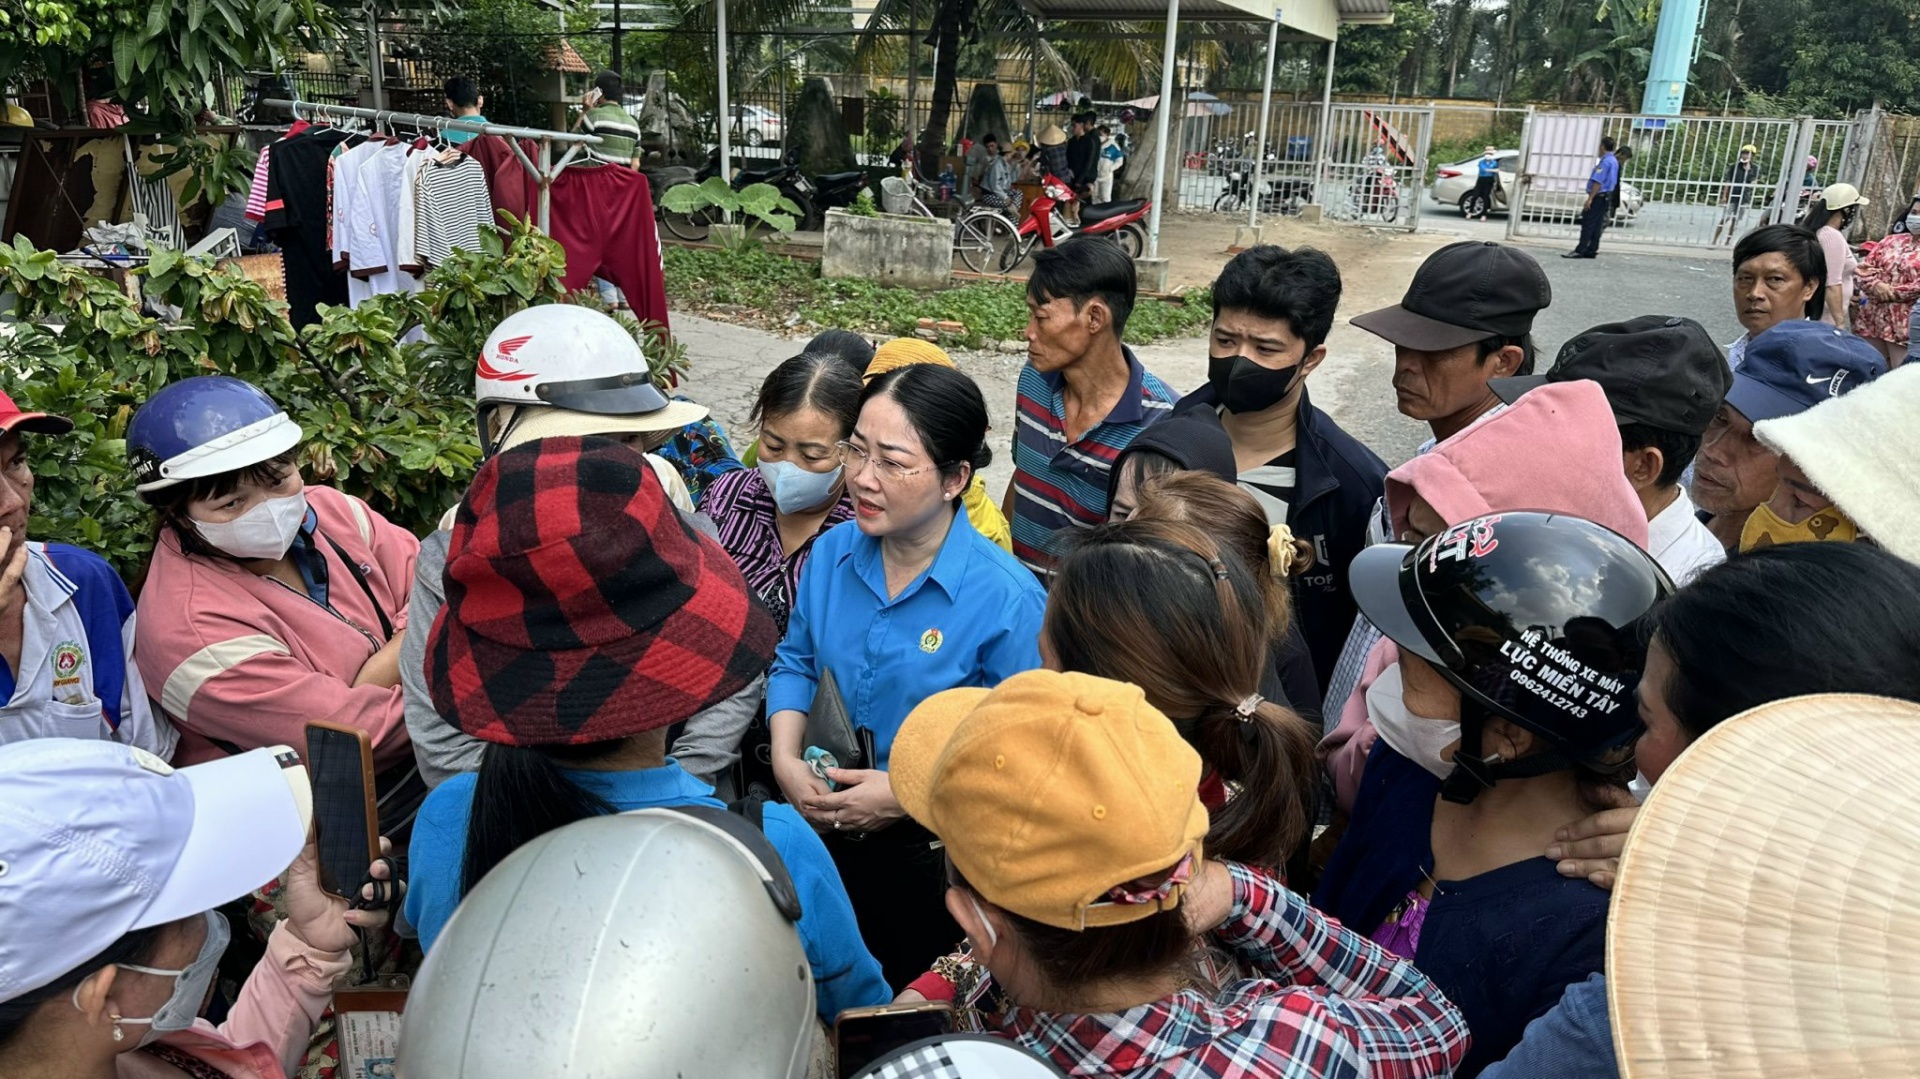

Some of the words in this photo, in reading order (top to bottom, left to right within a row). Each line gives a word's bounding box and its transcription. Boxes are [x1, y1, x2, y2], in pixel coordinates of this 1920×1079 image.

[496, 354, 519, 363] HONDA
[1830, 371, 1846, 394] NIKE
[1303, 573, 1333, 587] TOP
[1500, 640, 1538, 670] LỰC
[1537, 664, 1585, 698] MIỀN
[1585, 691, 1620, 714] TÂY
[1520, 629, 1541, 649] HỆ
[1540, 641, 1581, 673] THỐNG
[1579, 666, 1599, 682] XE
[1597, 675, 1625, 695] MÁY
[1510, 669, 1588, 718] 0962412743
